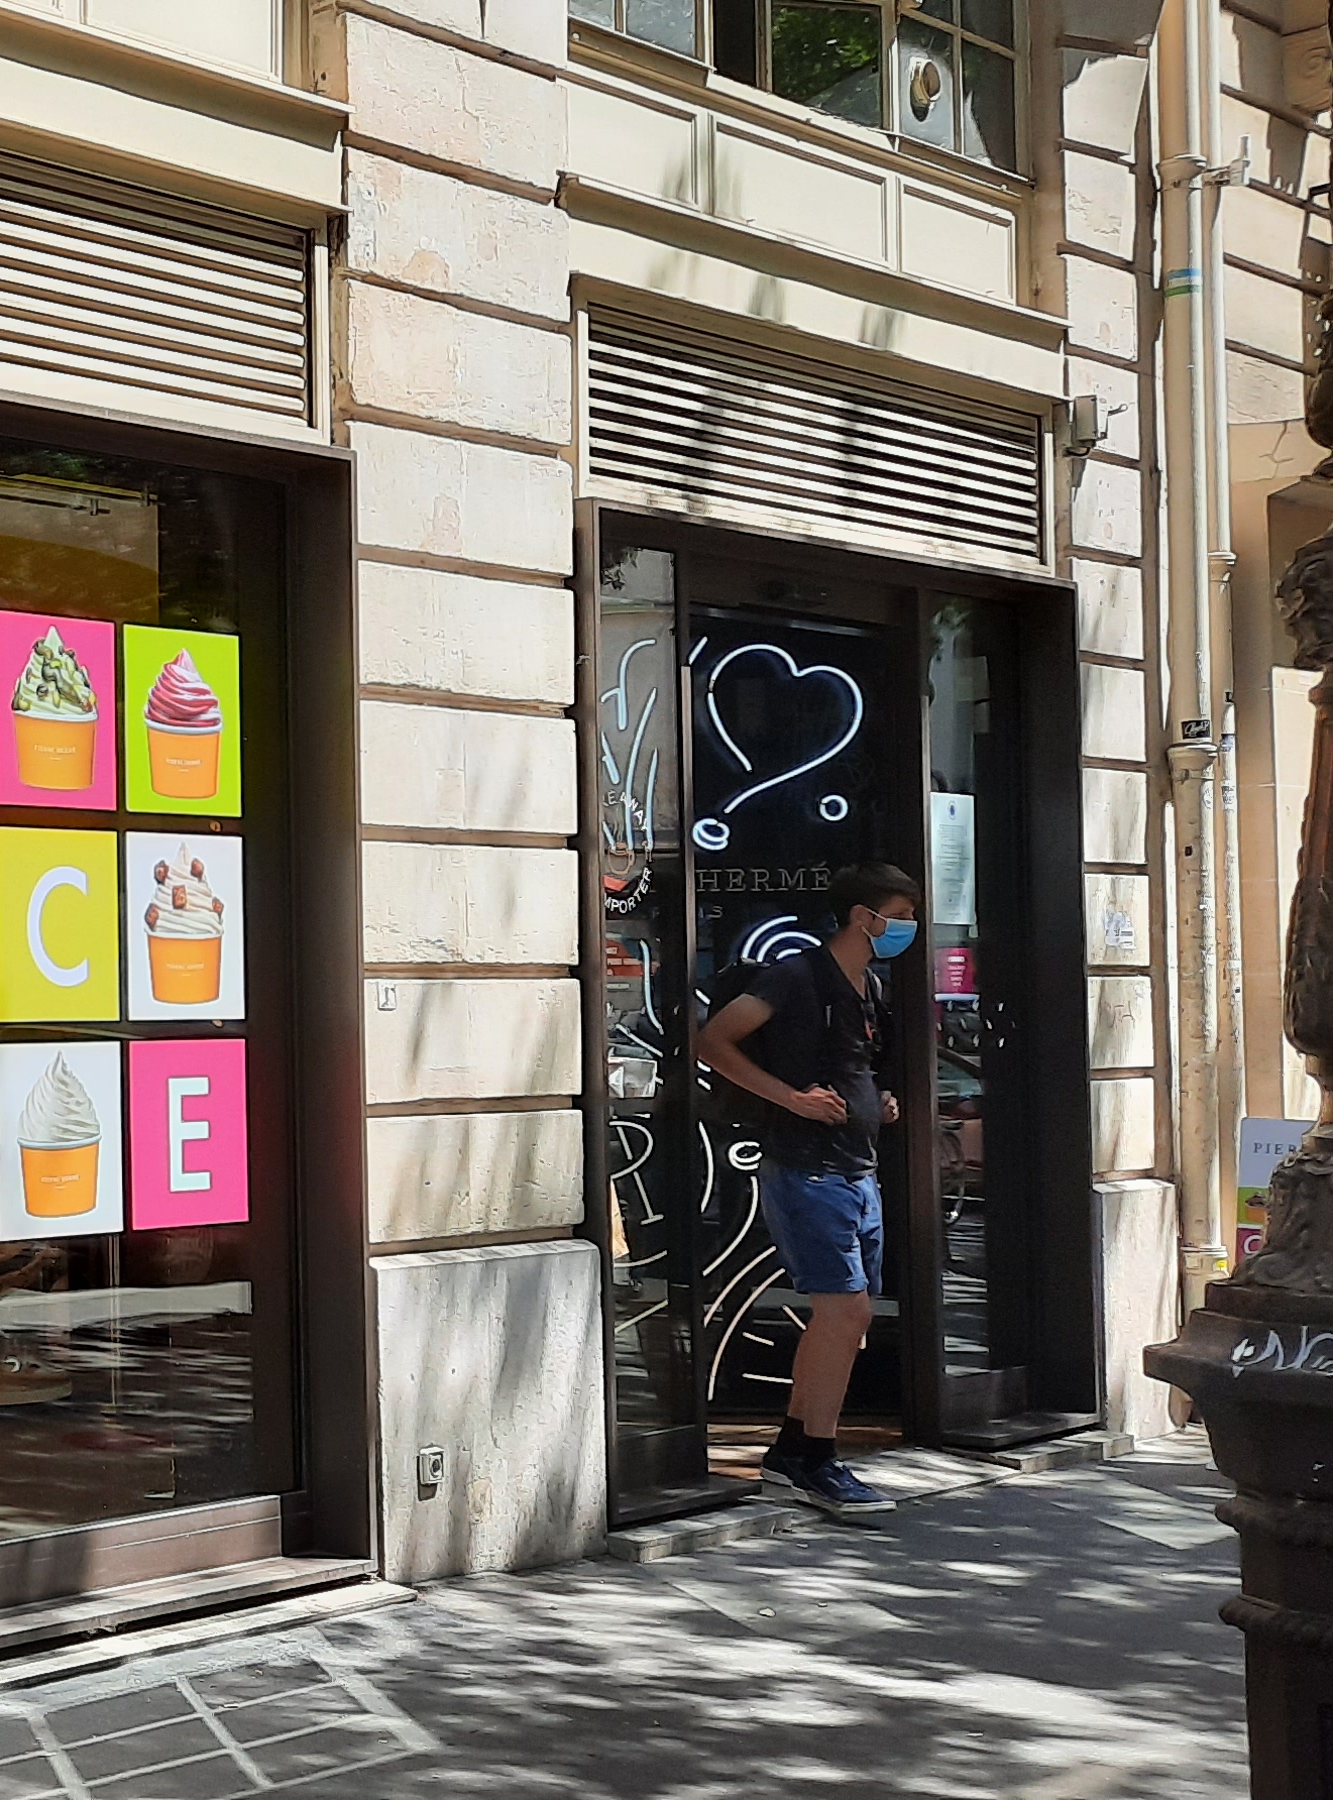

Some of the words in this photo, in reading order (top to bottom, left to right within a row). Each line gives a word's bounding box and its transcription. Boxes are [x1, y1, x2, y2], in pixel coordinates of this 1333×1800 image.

[603, 867, 653, 914] MPORTER
[695, 861, 832, 892] HERMÉ
[27, 866, 88, 986] C
[169, 1076, 211, 1192] E
[1253, 1142, 1298, 1155] PIER
